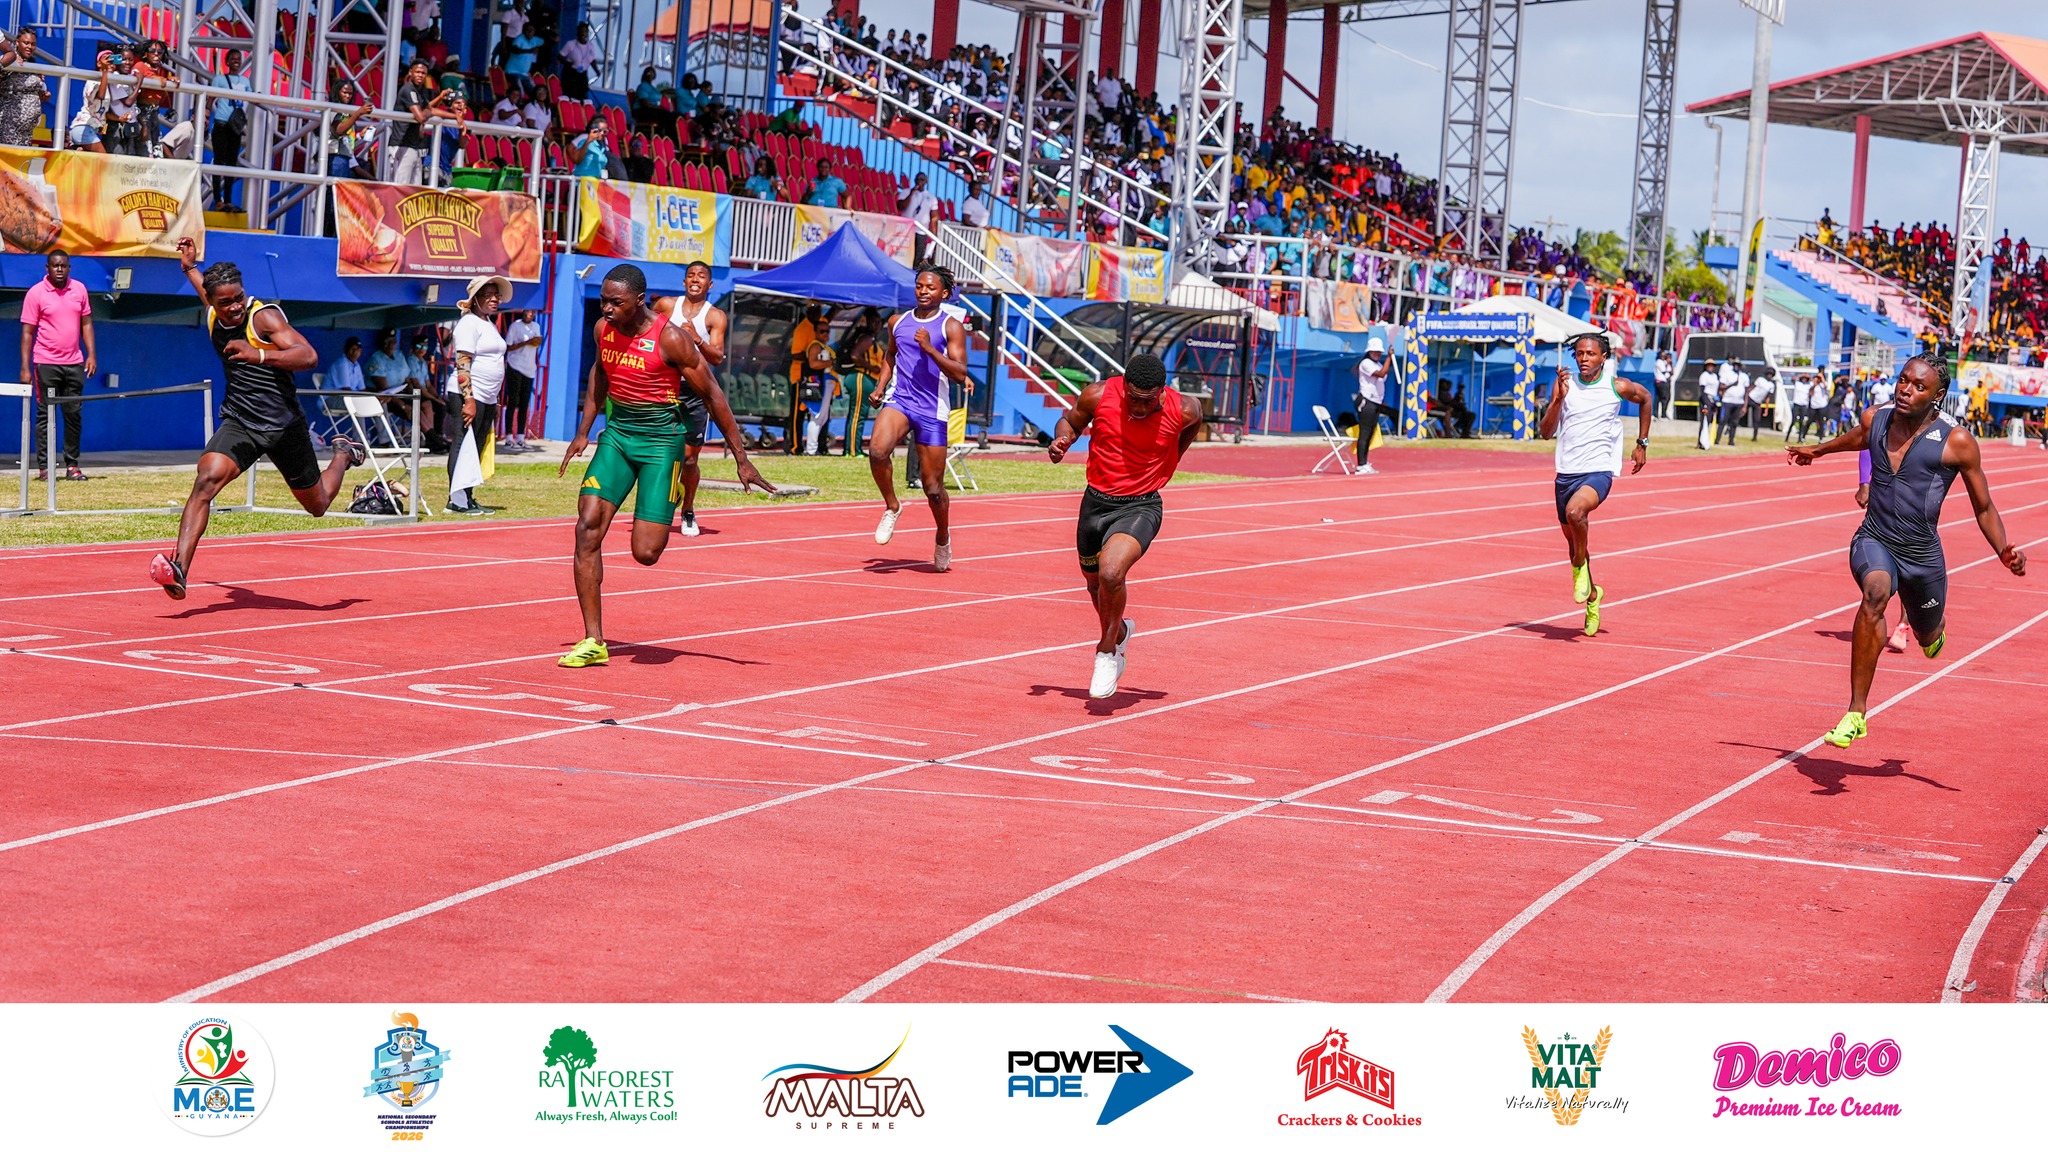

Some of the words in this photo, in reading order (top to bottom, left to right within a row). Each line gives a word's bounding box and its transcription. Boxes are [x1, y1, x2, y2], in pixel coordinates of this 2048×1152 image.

[121, 177, 138, 186] Whole
[121, 192, 147, 212] GOLDEN
[147, 192, 178, 214] HARVEST
[403, 195, 435, 225] GOLDEN
[438, 195, 478, 229] HARVEST
[656, 195, 702, 231] I-CEE
[143, 219, 165, 229] QUALITY
[427, 224, 455, 236] SUPERIOR
[430, 238, 458, 255] QUALITY
[1426, 320, 1443, 330] FIFA
[601, 348, 646, 371] GUYANA
